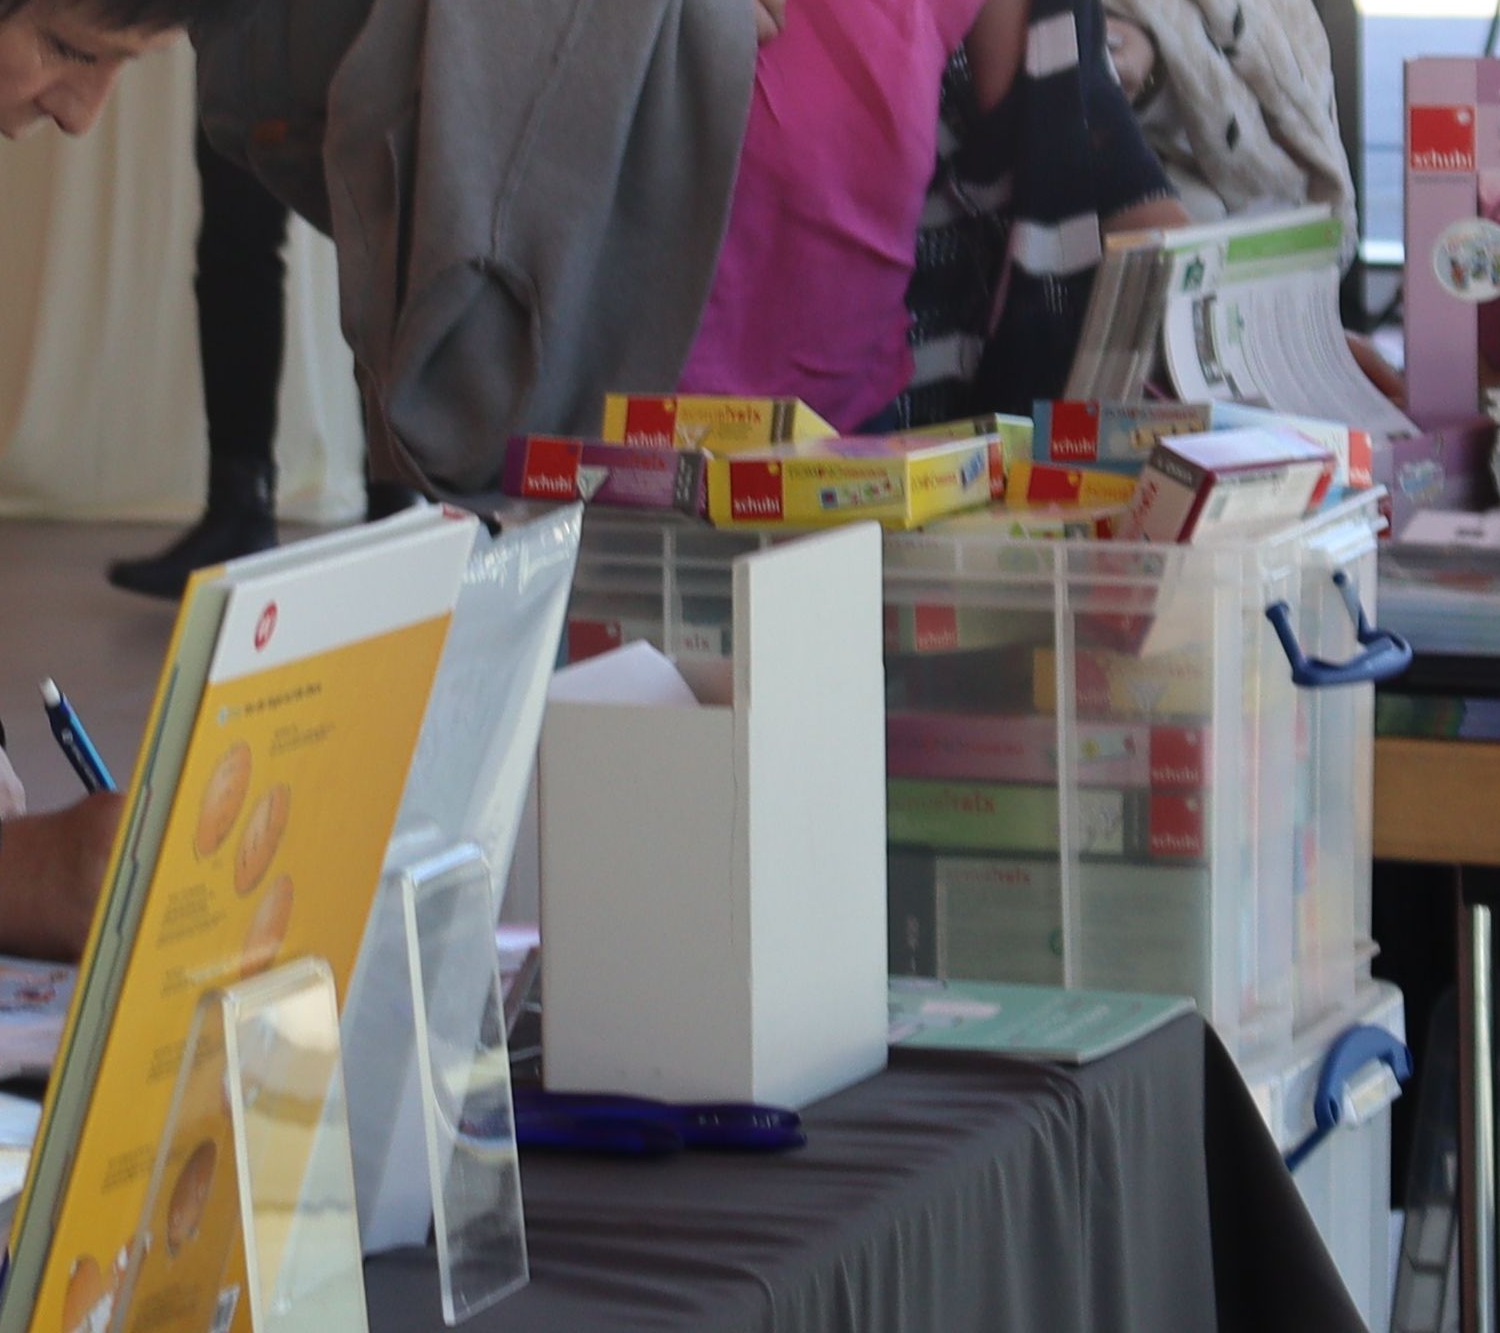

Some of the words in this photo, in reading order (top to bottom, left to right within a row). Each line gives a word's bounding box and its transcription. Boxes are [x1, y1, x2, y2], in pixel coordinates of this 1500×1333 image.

[1411, 149, 1474, 170] schubi
[627, 431, 672, 449] schubi
[1052, 434, 1097, 454] schubi
[526, 475, 573, 494] schubi
[733, 494, 781, 515] schubi
[1151, 765, 1199, 783] schubi
